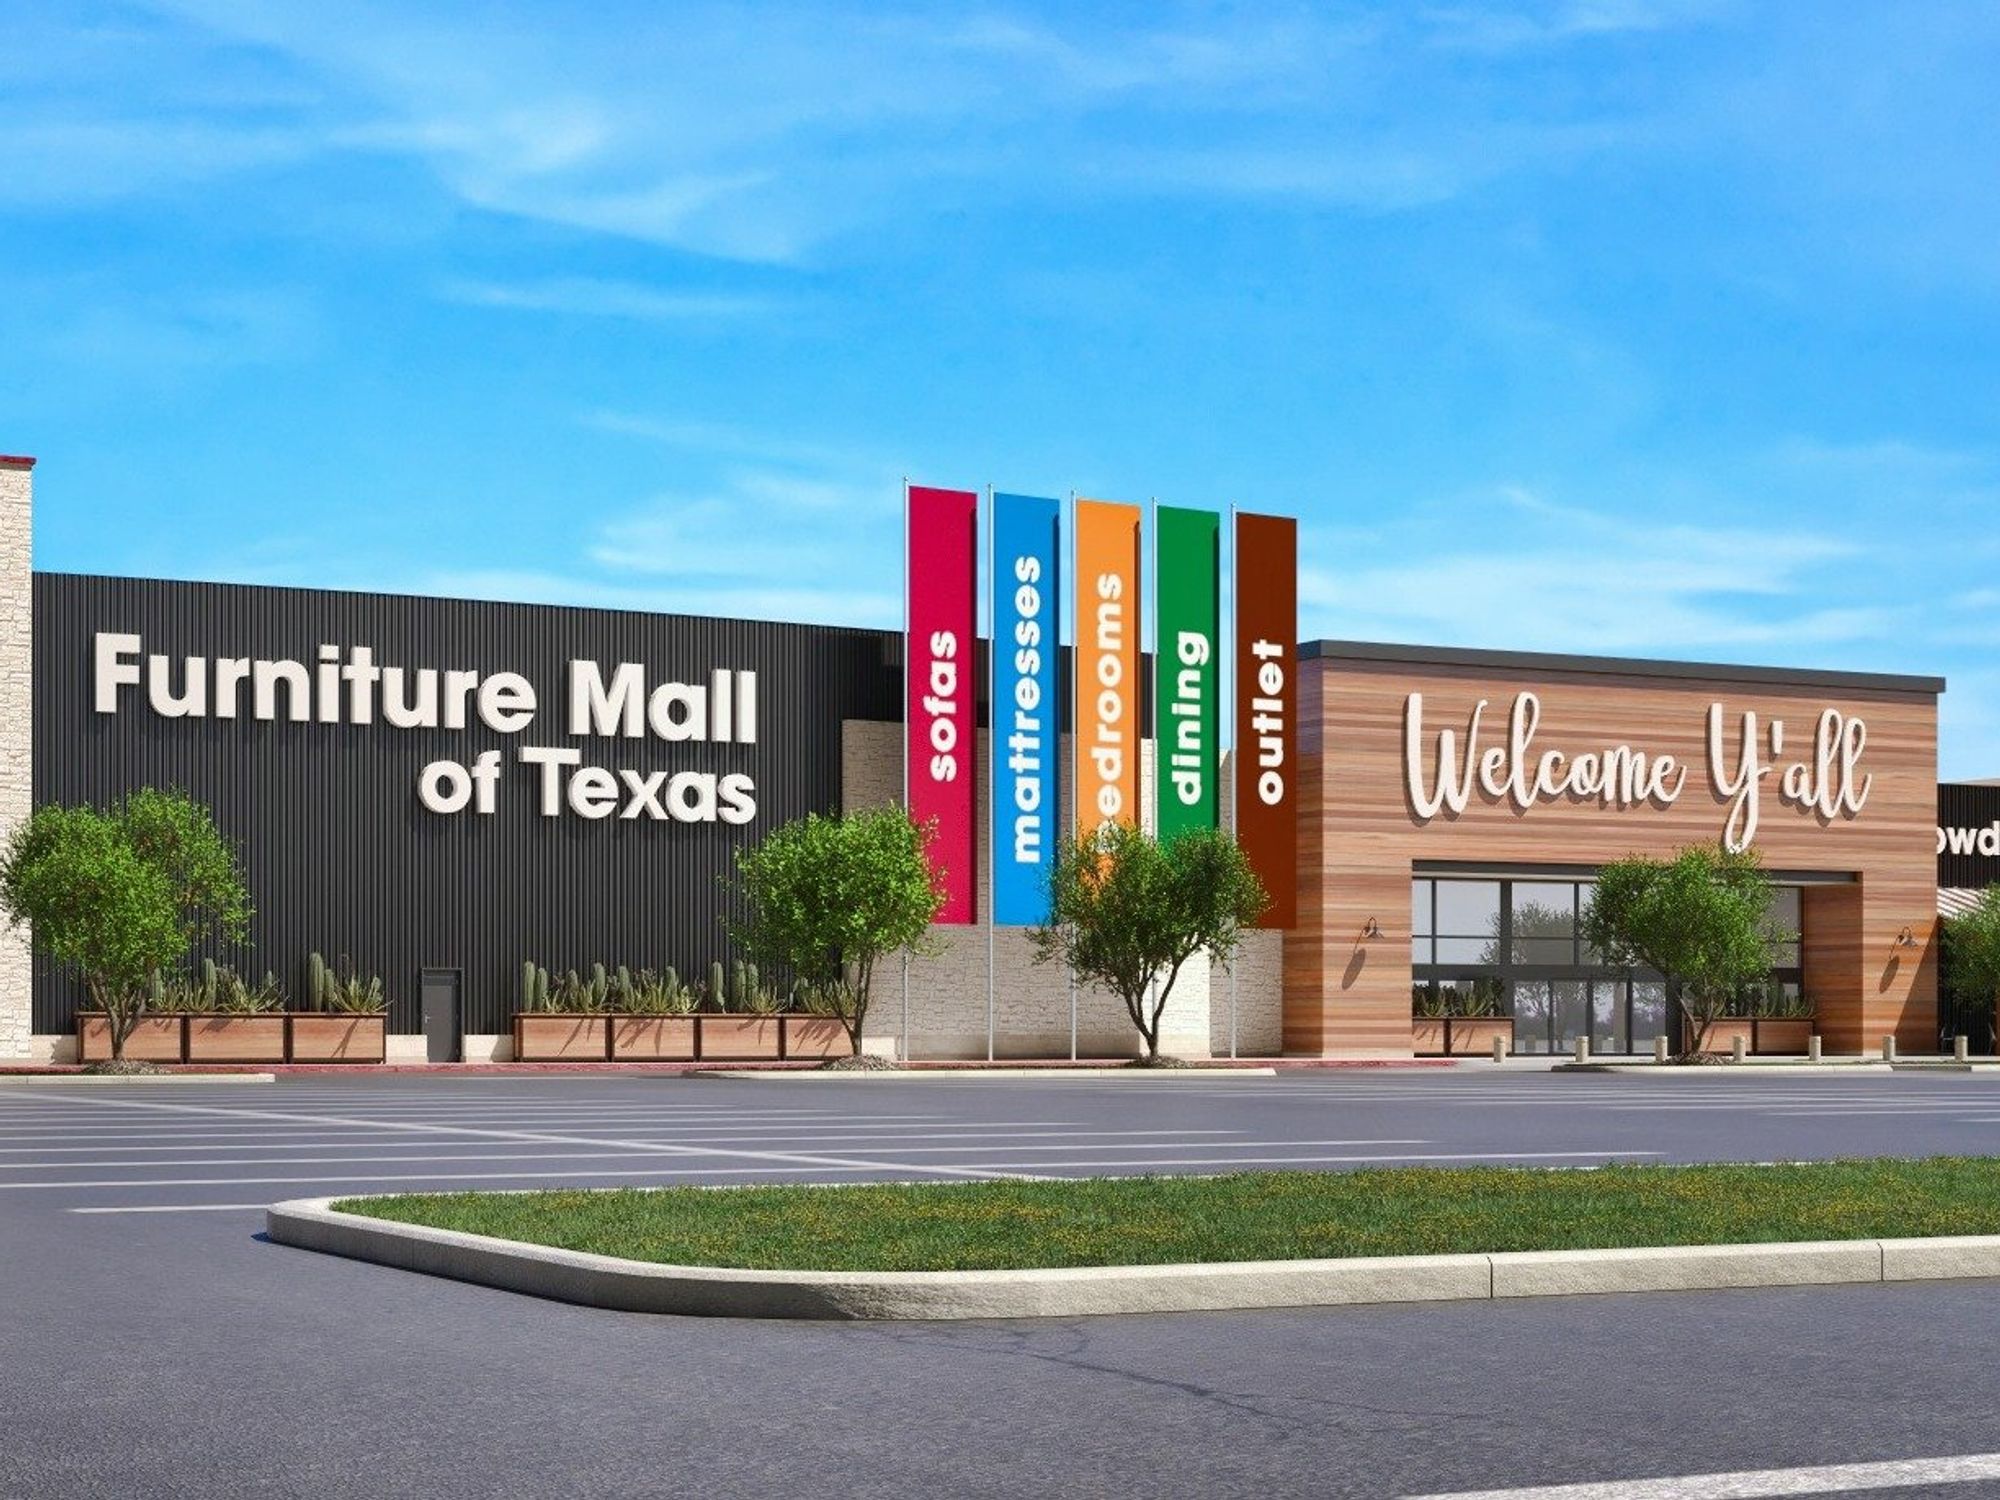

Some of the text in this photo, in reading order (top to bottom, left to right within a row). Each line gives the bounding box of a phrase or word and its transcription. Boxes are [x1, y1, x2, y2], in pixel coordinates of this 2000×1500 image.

[95, 632, 757, 744] Furniture Mall
[924, 630, 957, 783] sofas
[1009, 556, 1041, 863] mattresses
[1171, 630, 1210, 806] dining
[1252, 639, 1284, 806] outlet
[418, 745, 757, 825] of Texas
[1407, 691, 1872, 854] Welcome Y'all
